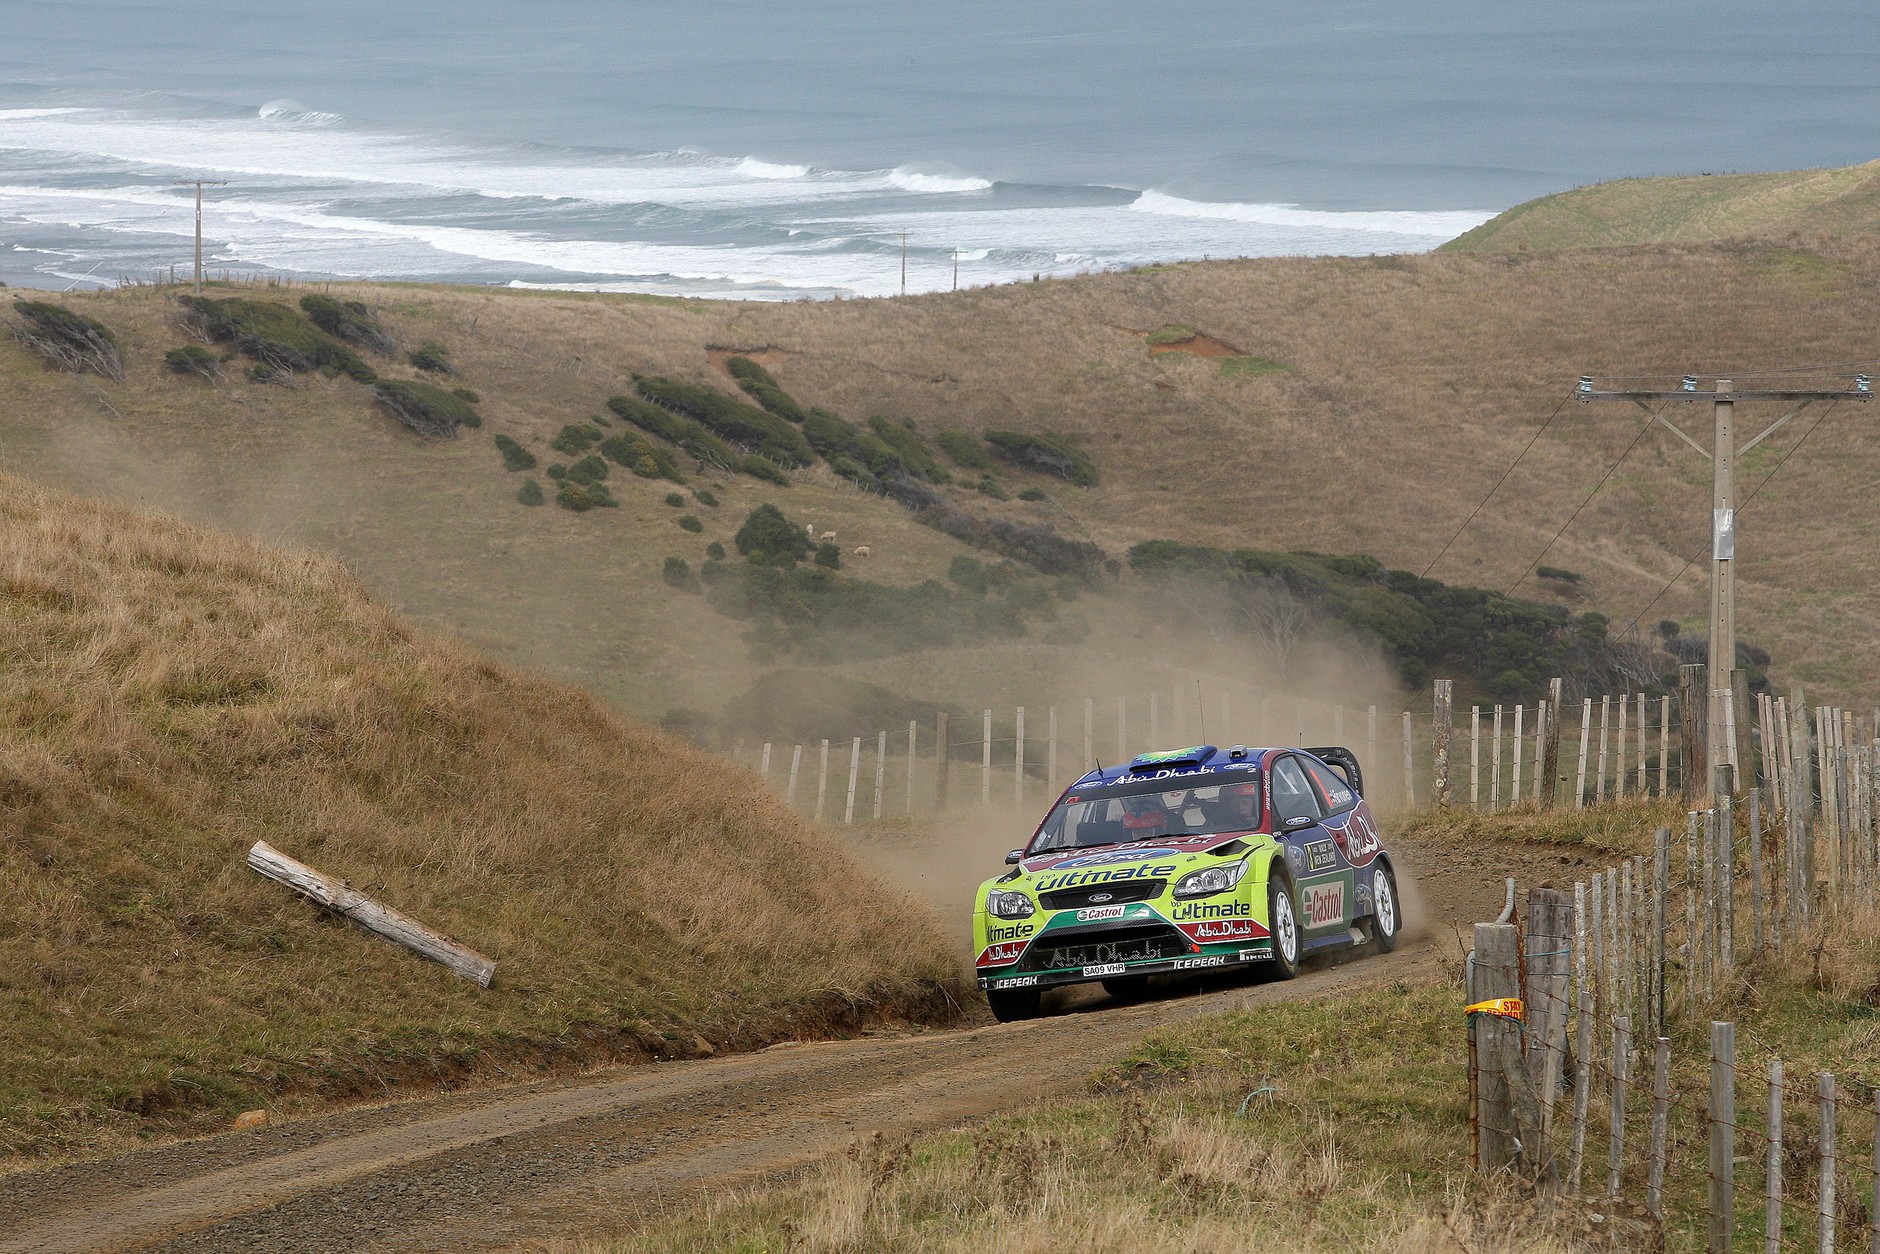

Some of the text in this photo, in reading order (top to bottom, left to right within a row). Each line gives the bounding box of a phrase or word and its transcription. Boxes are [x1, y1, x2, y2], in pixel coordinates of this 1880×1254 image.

[1034, 863, 1177, 892] ultimate
[1088, 906, 1122, 920] Castrol
[1172, 898, 1251, 921] ultimate
[1312, 886, 1342, 923] Castrol
[988, 921, 1034, 943] ltimate
[1084, 963, 1125, 976] SA09 VHR
[1172, 956, 1225, 970] ICEPEAK
[996, 975, 1038, 990] ICEPEAK
